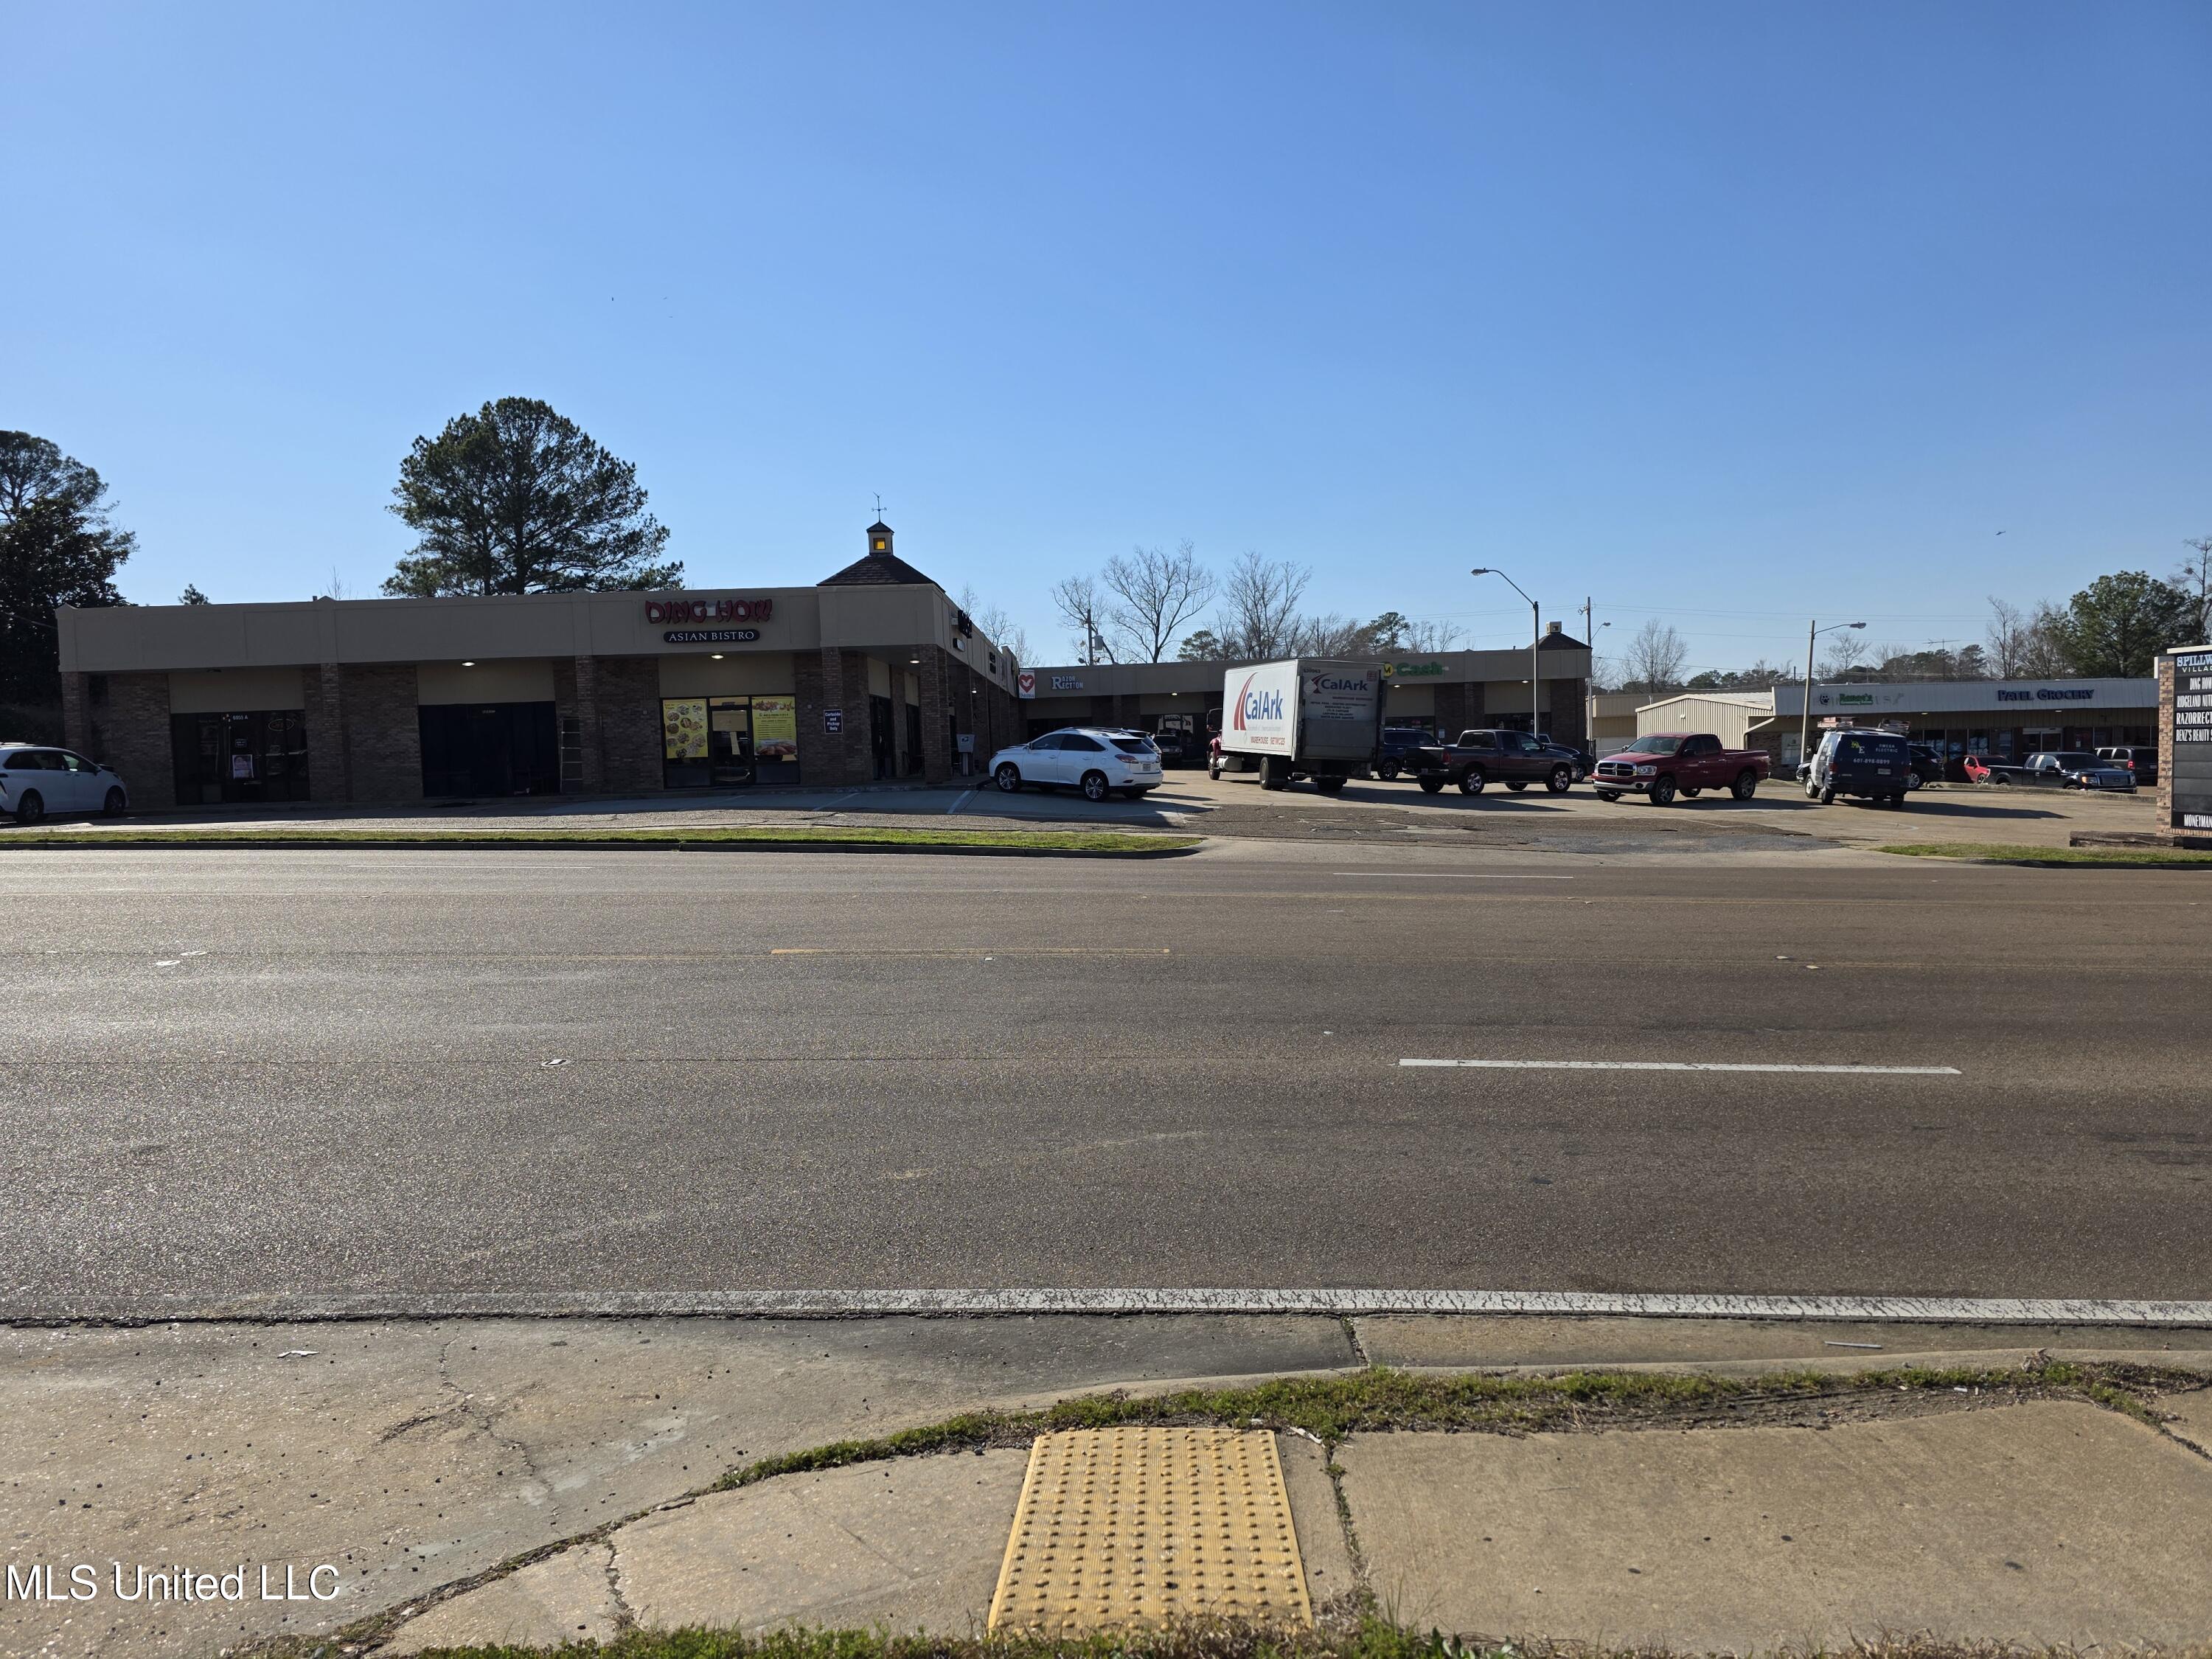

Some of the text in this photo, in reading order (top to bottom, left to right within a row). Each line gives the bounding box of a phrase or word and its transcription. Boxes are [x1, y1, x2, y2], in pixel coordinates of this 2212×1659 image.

[645, 599, 772, 624] DING HOW
[669, 631, 754, 641] ASIAN BISTRO
[1397, 661, 1442, 676] Cash
[1321, 679, 1368, 691] CalArk
[2190, 678, 2201, 690] DING
[1997, 689, 2095, 701] PATEL GROCERY
[1245, 689, 1284, 720] CalArk
[2177, 695, 2201, 708] RIDGELAND
[2193, 729, 2210, 741] BEAUTY
